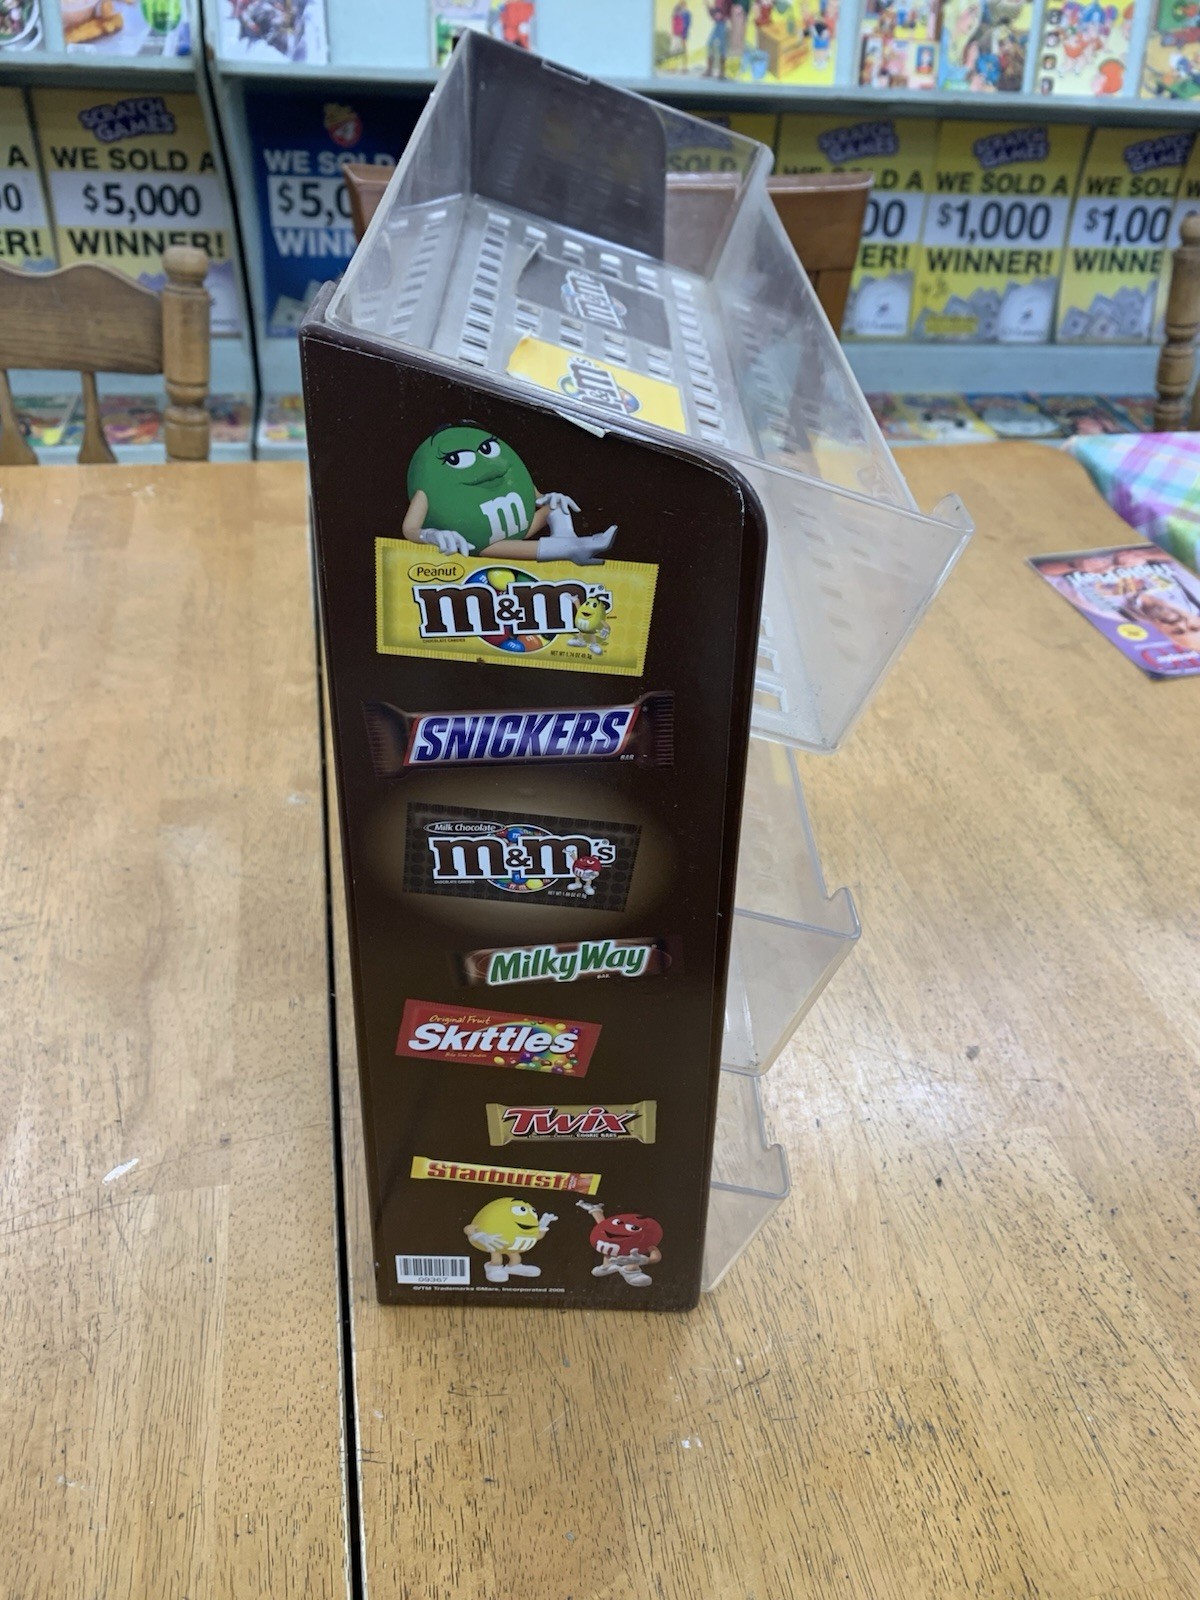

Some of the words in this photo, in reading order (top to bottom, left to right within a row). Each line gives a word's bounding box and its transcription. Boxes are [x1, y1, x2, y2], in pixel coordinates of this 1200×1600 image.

[95, 111, 176, 143] GAMES
[8, 144, 29, 167] A
[50, 146, 100, 170] WE
[109, 148, 188, 172] SOLD
[200, 151, 217, 173] A
[264, 149, 310, 174] WE
[905, 169, 923, 190] A
[936, 171, 973, 192] WE
[981, 171, 1045, 194] SOLD
[1052, 175, 1068, 195] A
[1088, 176, 1122, 196] WE
[1129, 176, 1179, 197] SOL
[83, 182, 202, 224] $5,000
[937, 200, 1052, 243] $1,000
[67, 228, 225, 258] WINNER!
[927, 249, 1053, 274] WINNER!
[416, 566, 458, 577] Peanut
[413, 710, 631, 762] SNICKERS
[434, 823, 454, 831] Milk
[455, 823, 497, 832] Chocolate
[428, 834, 617, 879] m&m's
[488, 947, 578, 983] Milky
[579, 941, 648, 976] Way
[429, 1014, 466, 1025] Original
[466, 1015, 491, 1025] Fruit
[408, 1022, 579, 1053] Skittles
[503, 1106, 636, 1135] Twix
[427, 1161, 565, 1189] Starburst
